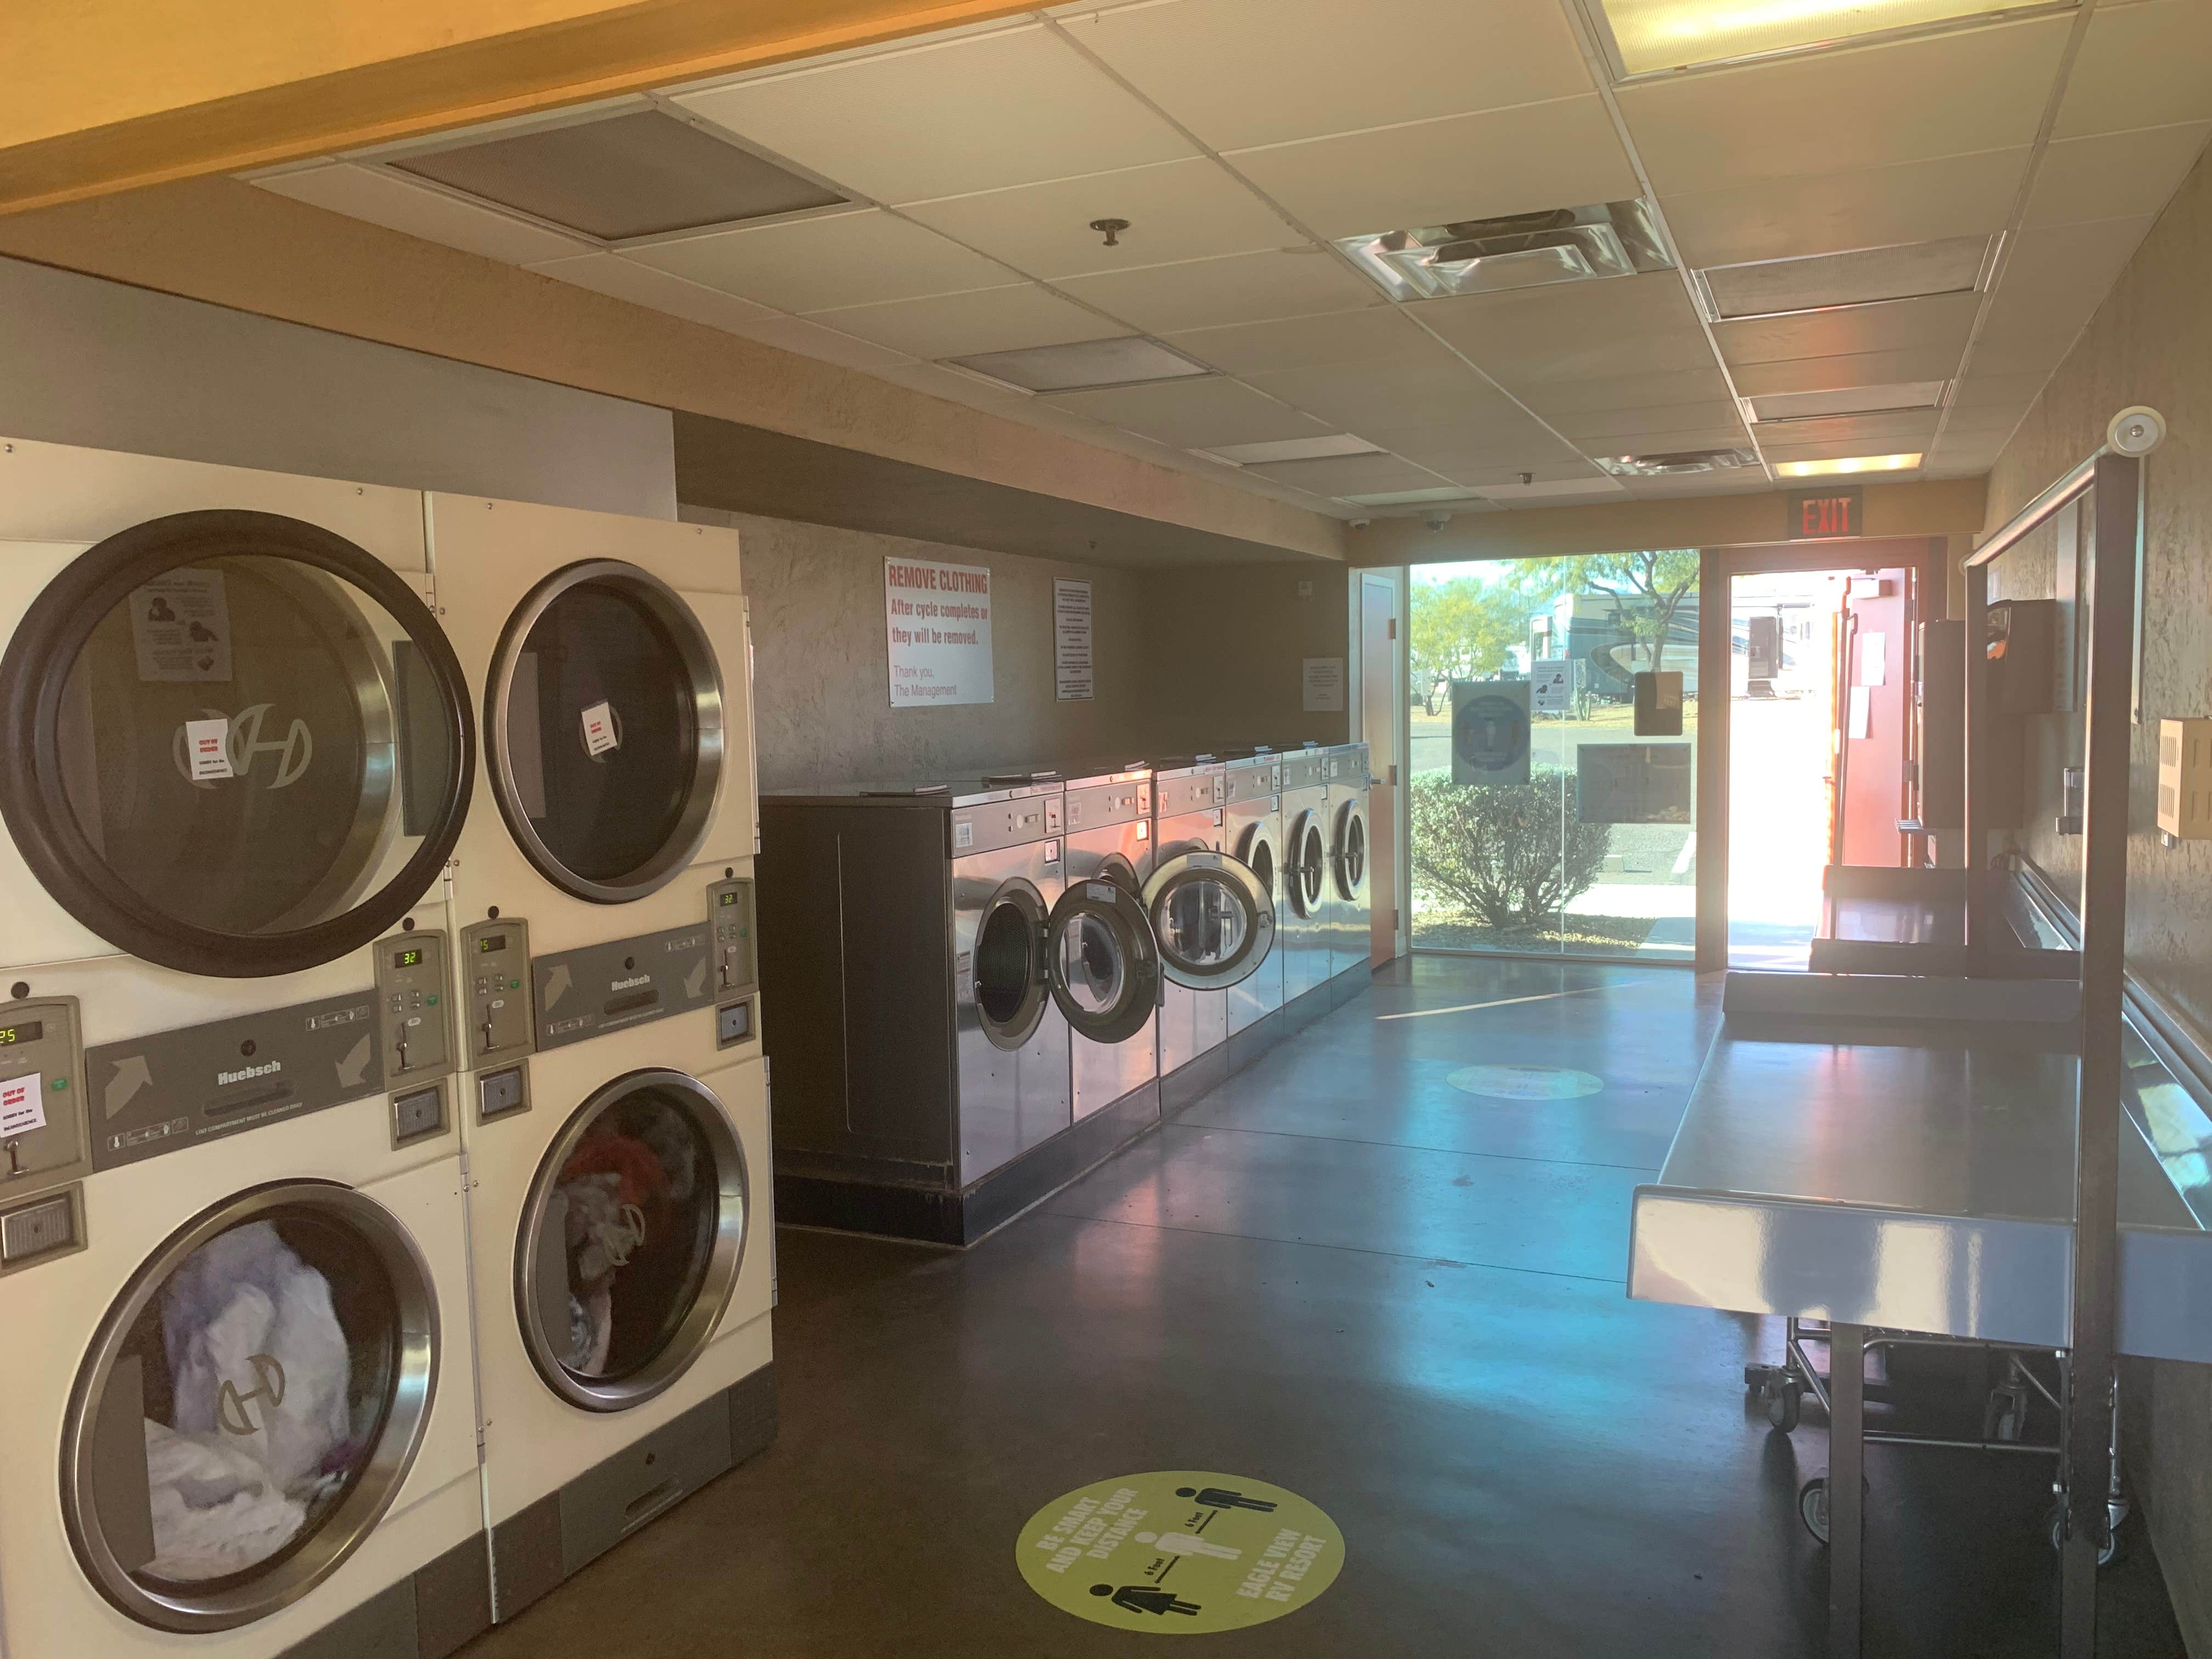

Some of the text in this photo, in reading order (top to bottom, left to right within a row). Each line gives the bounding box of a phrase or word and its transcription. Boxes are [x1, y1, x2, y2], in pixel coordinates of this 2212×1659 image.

[1803, 497, 1851, 535] EXIT
[888, 565, 988, 594] REMOVE CLOTHING
[891, 599, 988, 622] After cycle completes or
[893, 627, 978, 646] they will be removed.
[894, 665, 917, 678] Thank
[894, 684, 957, 699] The Management
[405, 952, 416, 964] 32
[612, 974, 650, 992] Huebsch
[218, 1060, 281, 1086] Huebsch
[2, 1089, 16, 1098] OUT
[3, 1096, 25, 1106] ORDER
[1036, 1496, 1101, 1551] BE SMART
[1046, 1488, 1139, 1573] AND KEEP YOUR
[1086, 1507, 1149, 1559] DISTANCE
[1236, 1528, 1301, 1599] EAGLE VIEW
[1264, 1535, 1326, 1602] RV RESORT
